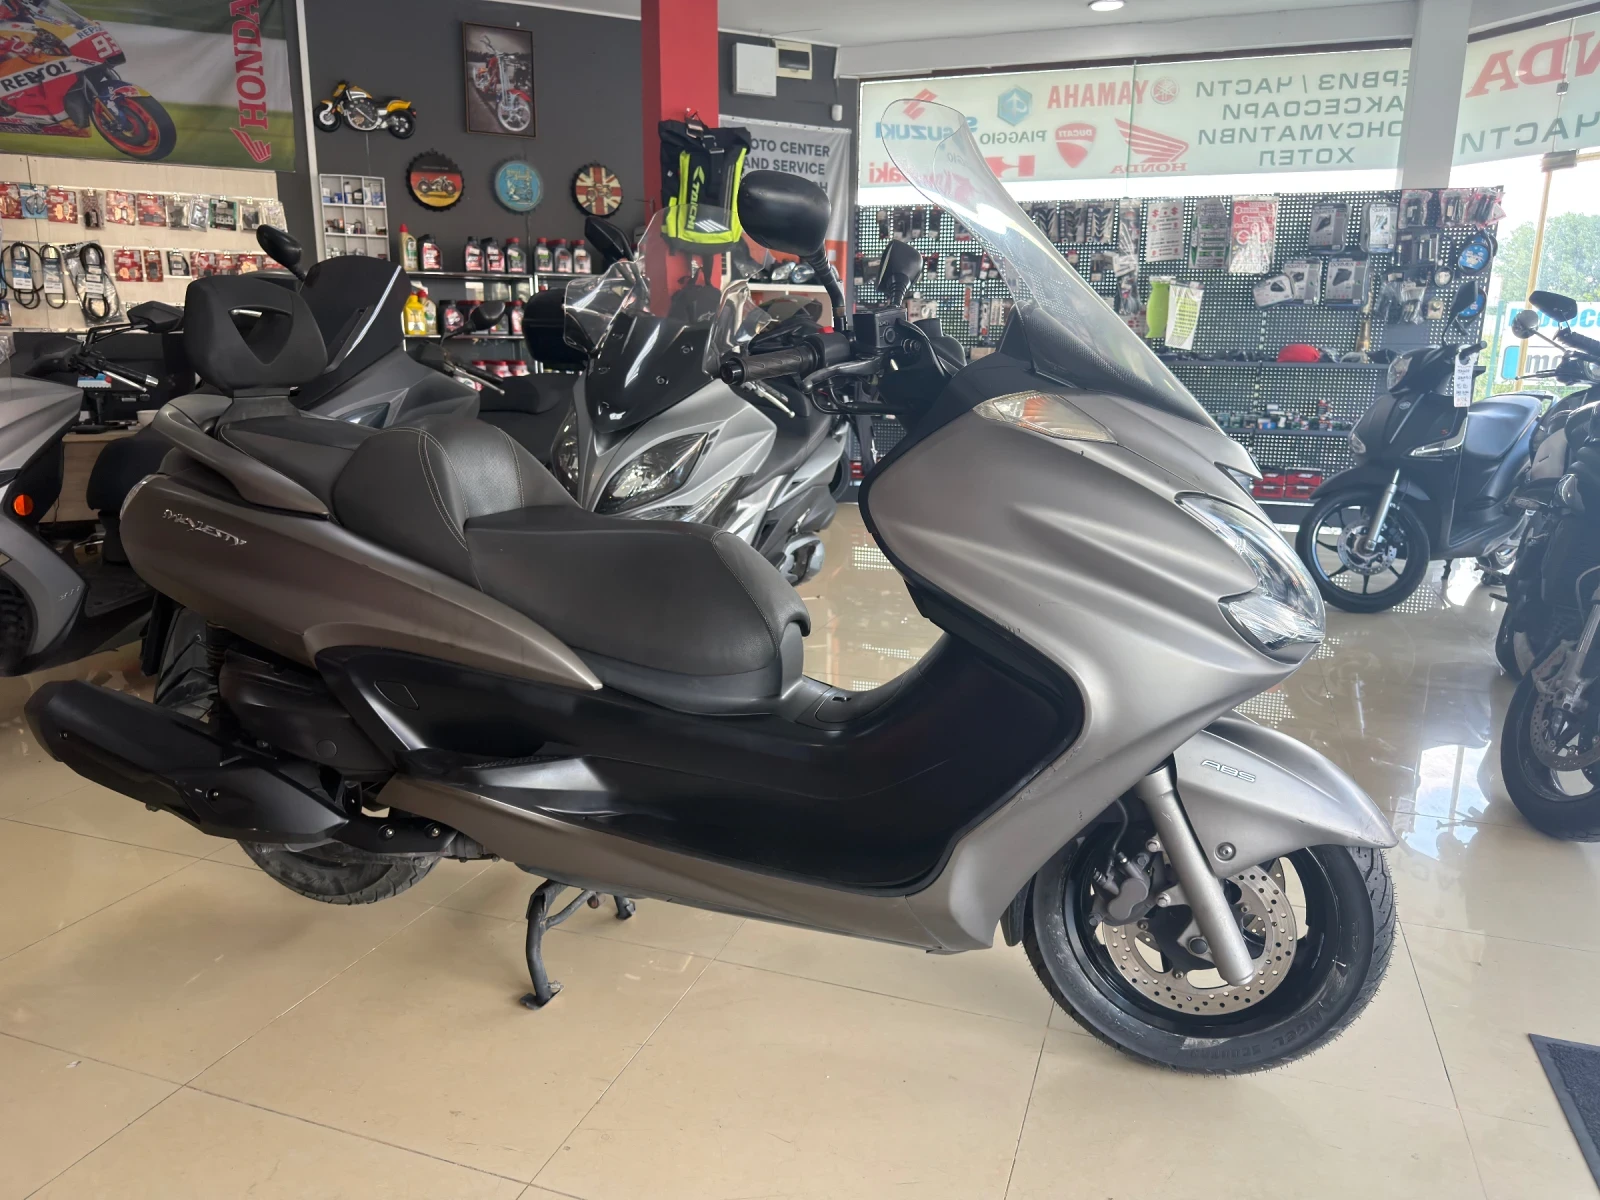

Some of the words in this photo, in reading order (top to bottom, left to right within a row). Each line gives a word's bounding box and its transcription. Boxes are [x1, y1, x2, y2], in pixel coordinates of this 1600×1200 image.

[2, 61, 72, 92] REPSOL
[229, 0, 269, 129] HONDA
[780, 141, 830, 157] CENTER
[744, 156, 769, 170] AND
[773, 158, 825, 175] SERVICE
[1201, 759, 1256, 783] ABS
